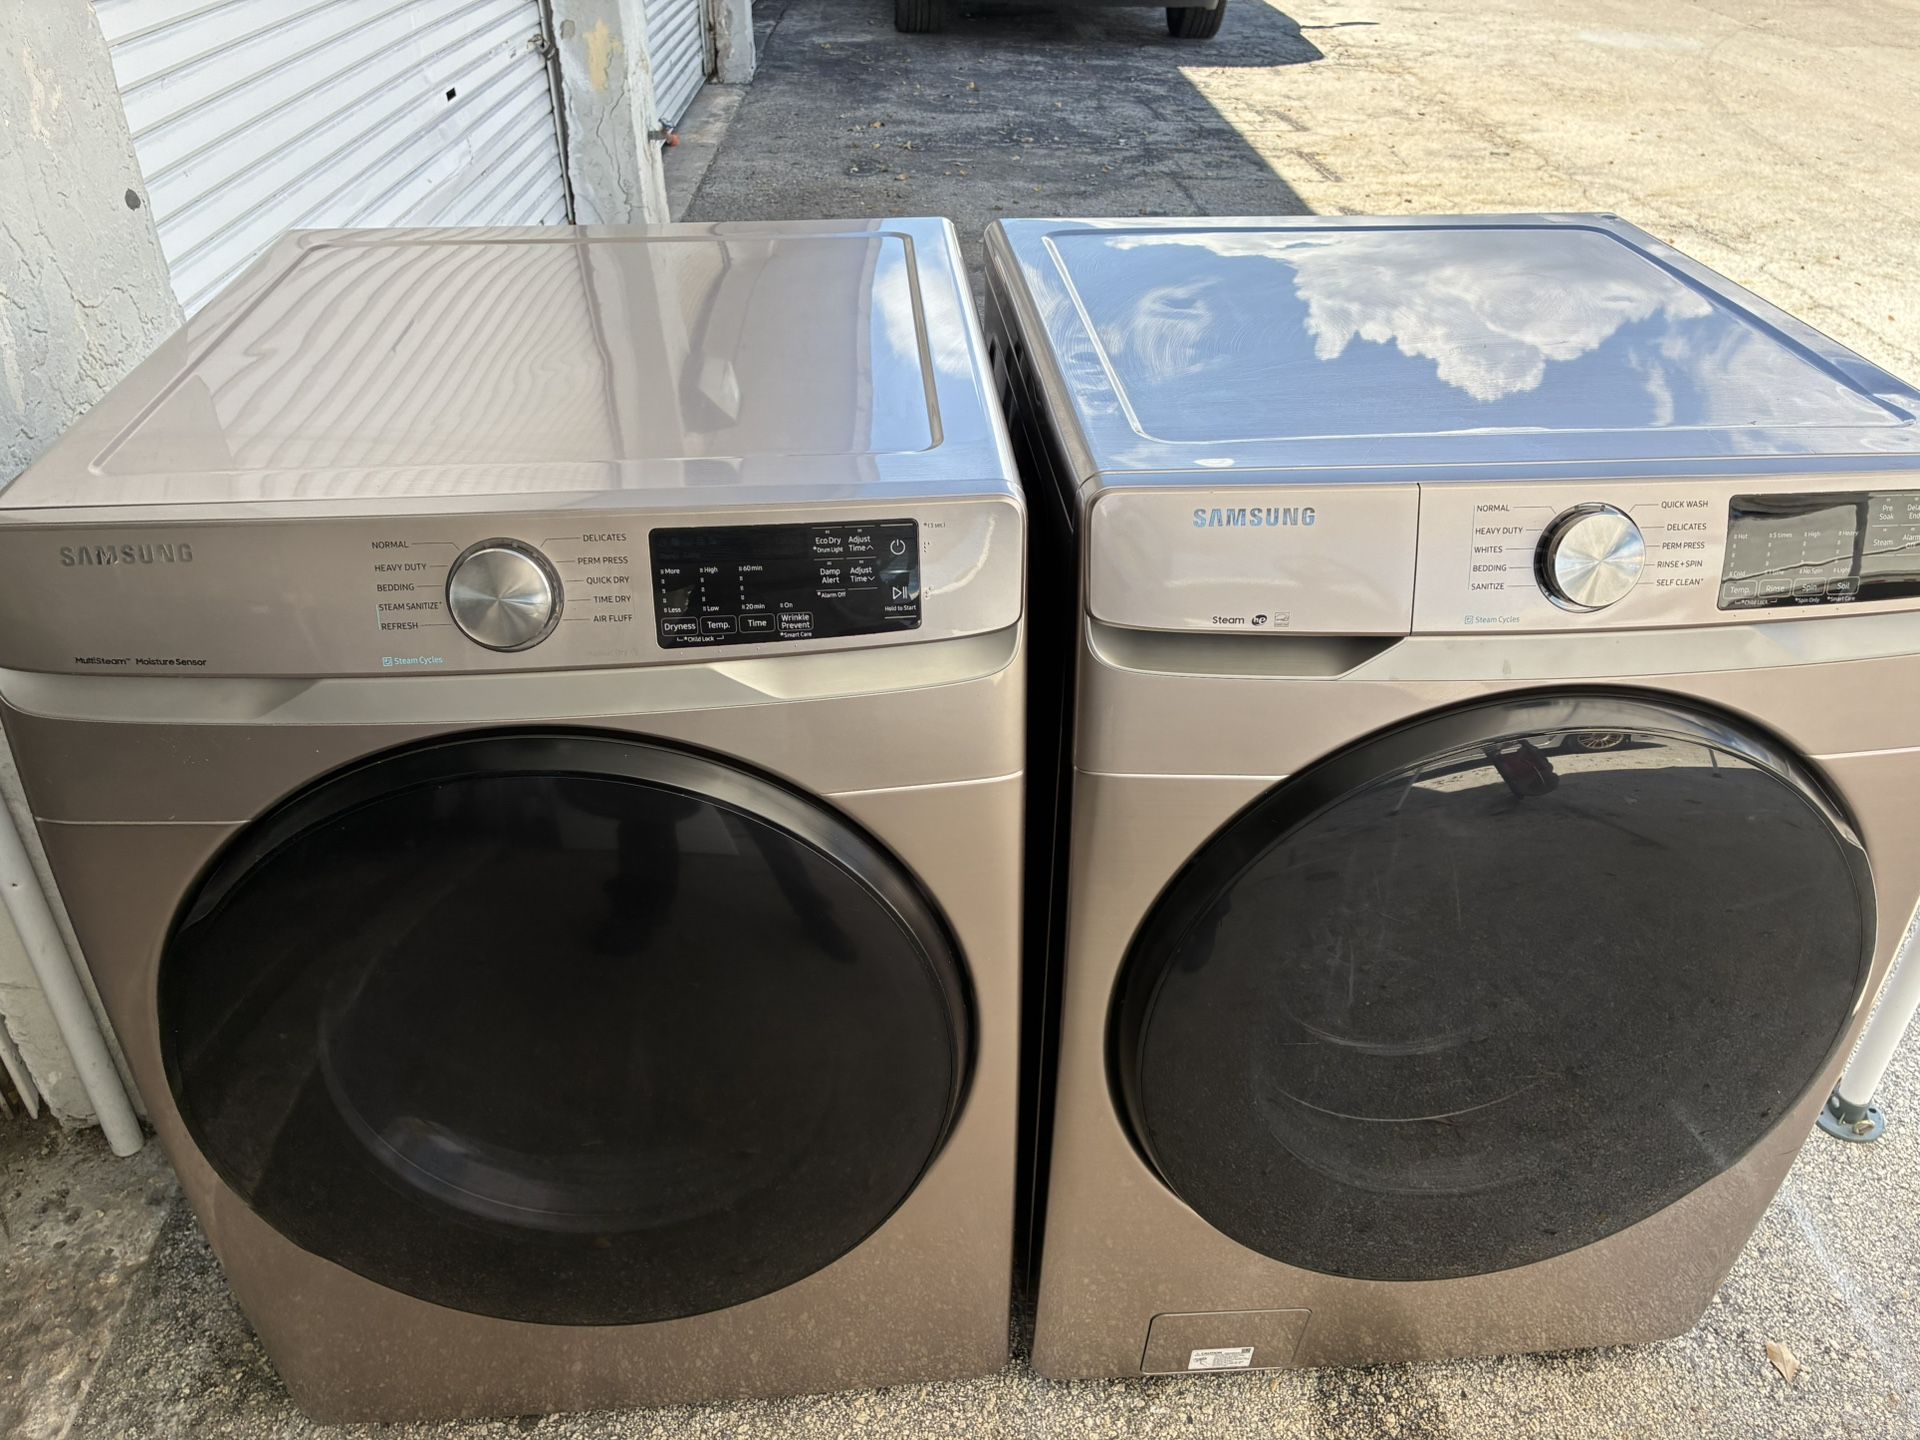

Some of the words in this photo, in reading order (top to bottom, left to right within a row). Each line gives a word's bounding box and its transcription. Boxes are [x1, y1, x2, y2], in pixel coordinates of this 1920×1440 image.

[1476, 504, 1510, 513] NORMAL
[1661, 500, 1684, 509] QUICK
[1685, 500, 1709, 508] WASH
[1192, 507, 1316, 528] SAMSUNG
[1475, 526, 1501, 535] HEAVY
[1502, 526, 1523, 534] DUTY
[1666, 523, 1707, 531] DELICATES
[582, 534, 627, 542] DELICATES
[815, 537, 828, 545] Eco
[828, 537, 841, 545] Dry
[848, 535, 871, 544] Adjust
[371, 540, 409, 549] NORMAL
[1662, 541, 1682, 550] PERM
[1683, 541, 1705, 549] PRESS
[1474, 546, 1503, 554] WHITES
[60, 543, 193, 567] SAMSUNG
[577, 557, 600, 565] PERM
[602, 556, 628, 565] PRESS
[1657, 560, 1680, 568] RINSE
[1685, 560, 1703, 568] SPIN
[374, 563, 402, 572] HEAVY
[404, 563, 427, 571] DUTY
[820, 568, 841, 576] Damp
[850, 567, 873, 575] Adjust
[1472, 564, 1507, 572] BEDDING
[586, 576, 609, 585] QUICK
[610, 576, 630, 584] DRY
[822, 576, 840, 584] Alert
[1656, 579, 1674, 587] SELF
[377, 583, 415, 592] BEDDING
[1471, 582, 1505, 591] SANITIZE
[1766, 584, 1786, 592] Rinse
[1802, 584, 1818, 593] Spin
[1837, 582, 1850, 590] Soil
[593, 595, 613, 604] TIME
[614, 595, 631, 603] DRY
[378, 603, 404, 611] STEAM
[593, 614, 607, 622] AIR
[609, 614, 633, 622] FLUFF
[781, 613, 810, 622] Wrinkle
[1212, 615, 1245, 625] Steam
[1475, 615, 1497, 624] Steam
[1498, 615, 1520, 624] Cycles
[381, 622, 418, 631] REFRESH
[664, 622, 696, 632] Dryness
[707, 621, 731, 630] Temp.
[747, 619, 767, 628] Time
[781, 621, 811, 630] Prevent
[135, 657, 175, 666] Moisture
[175, 658, 207, 666] Sensor
[394, 657, 418, 665] Steam
[419, 656, 443, 665] Cycles
